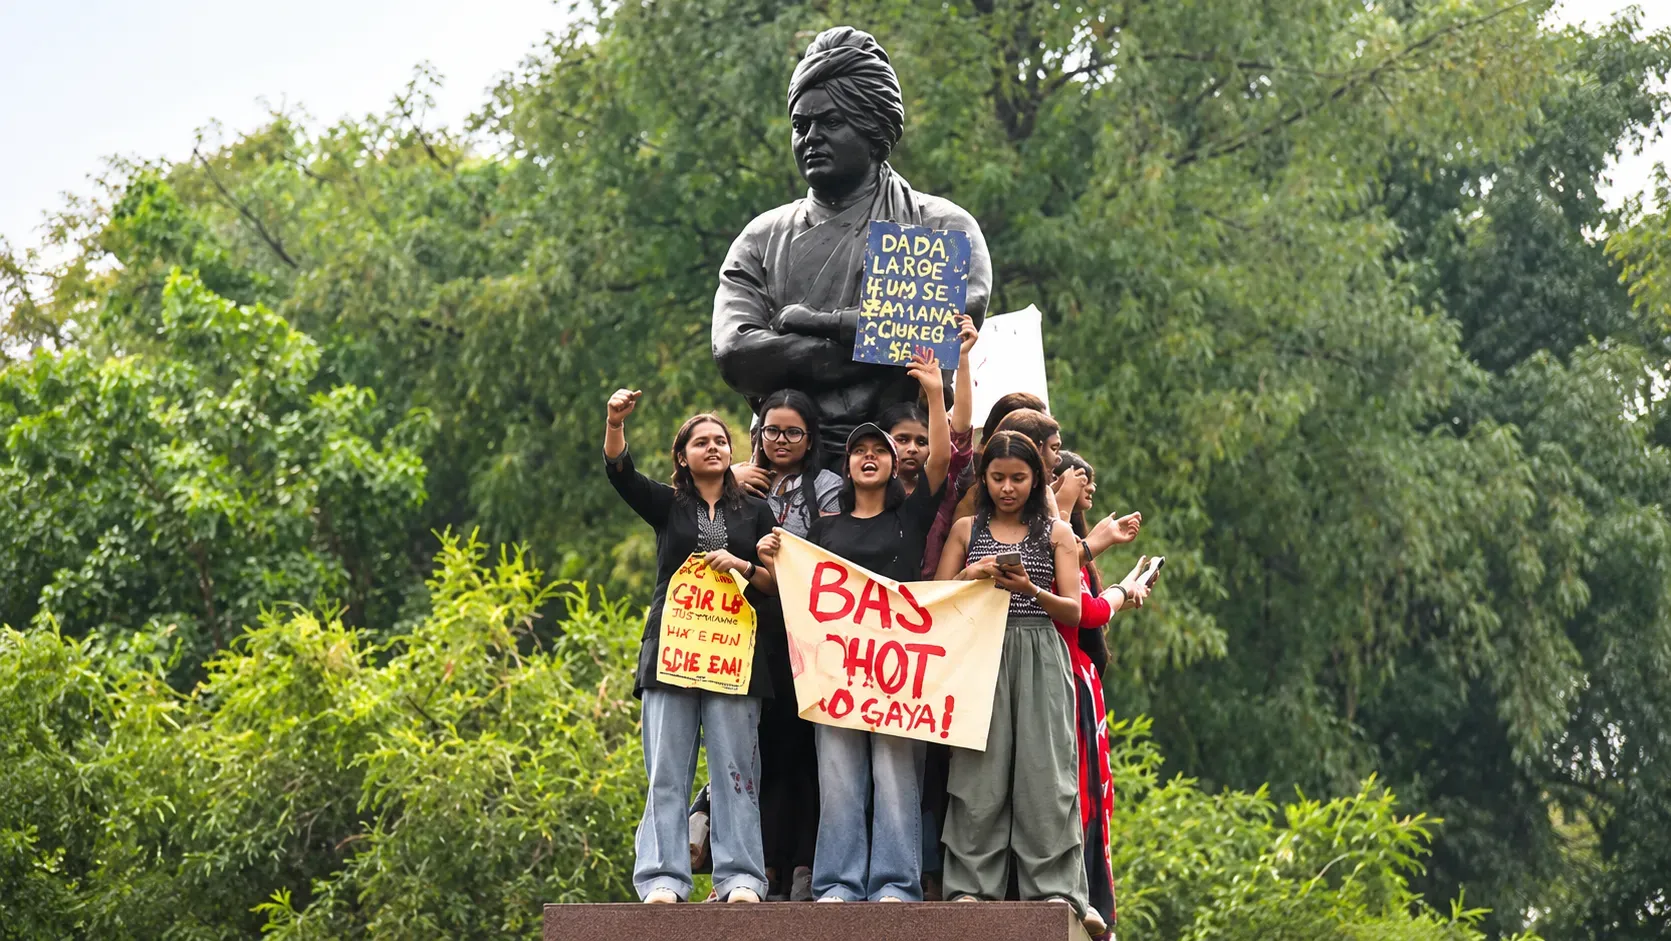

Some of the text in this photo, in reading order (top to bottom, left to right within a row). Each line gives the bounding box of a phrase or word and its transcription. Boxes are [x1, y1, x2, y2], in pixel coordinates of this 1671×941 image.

[922, 282, 949, 301] SE
[711, 632, 741, 646] FUN
[860, 695, 955, 739] GAYA!
